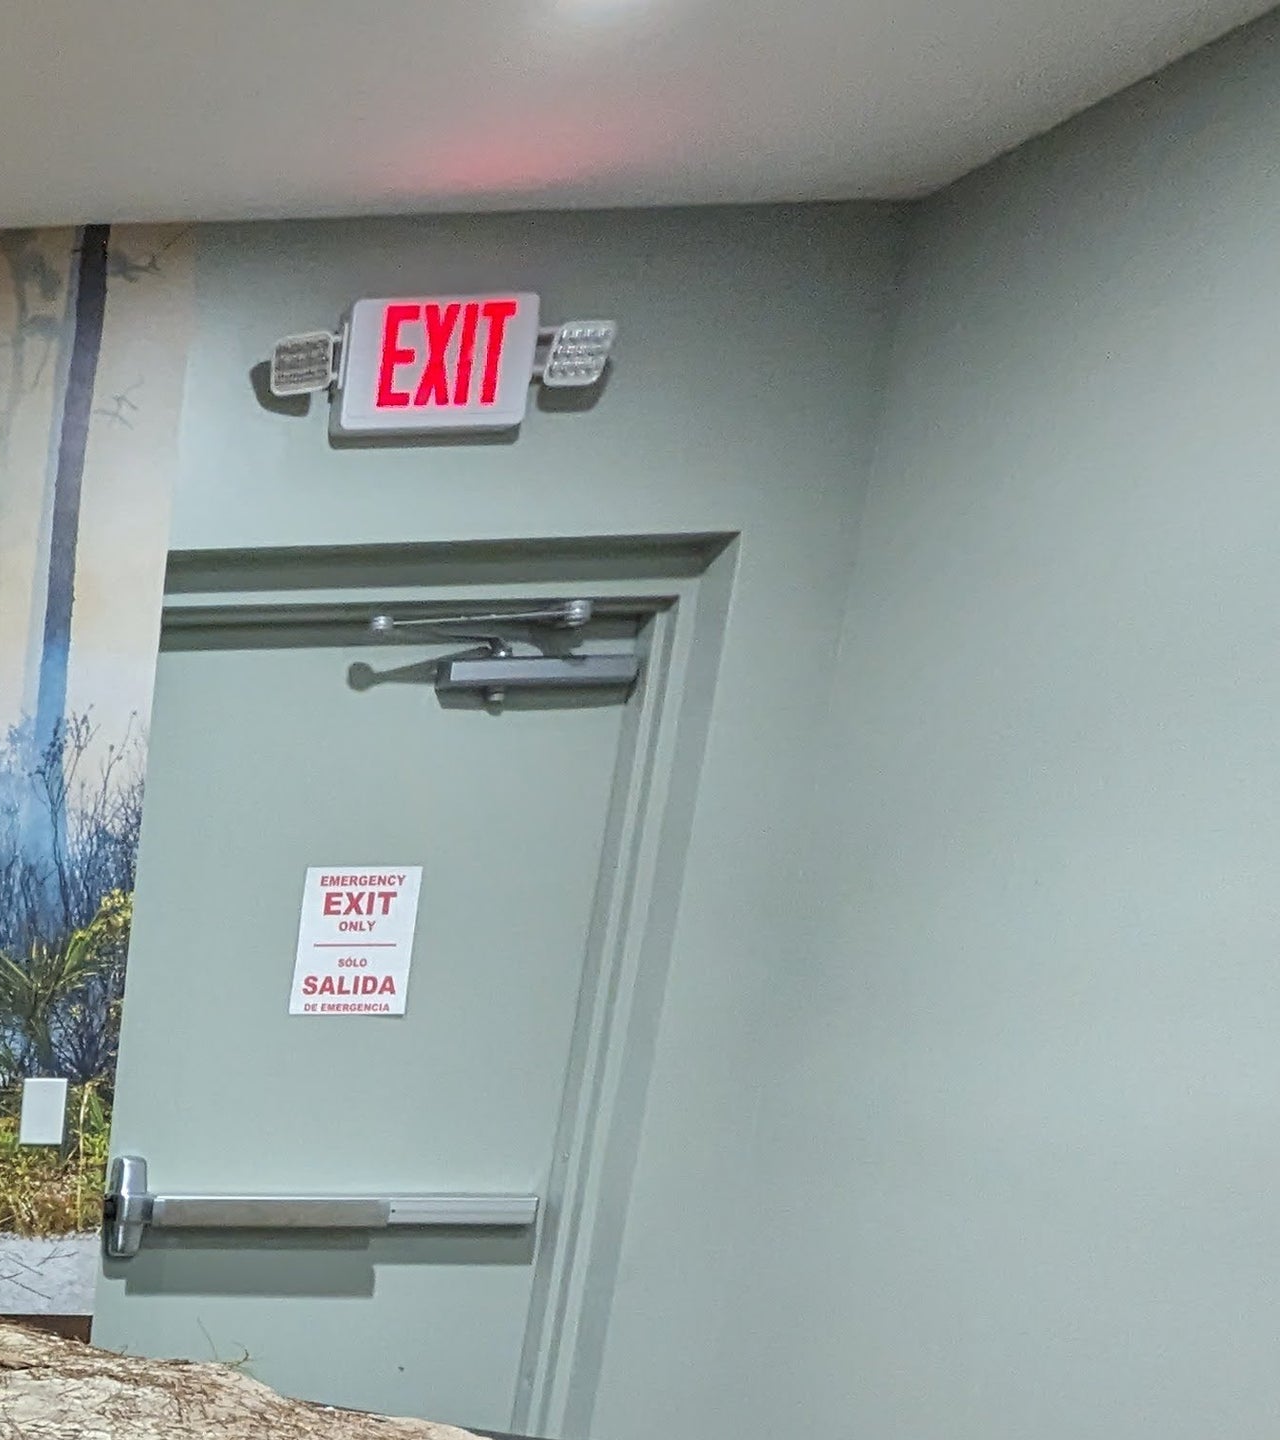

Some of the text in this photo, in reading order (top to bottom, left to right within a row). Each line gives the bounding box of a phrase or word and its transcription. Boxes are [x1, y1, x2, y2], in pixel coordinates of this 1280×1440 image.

[377, 301, 517, 408] EXIT
[321, 875, 406, 886] EMERGENCY
[323, 892, 397, 916] EXIT
[339, 921, 376, 931] ONLY
[338, 957, 367, 967] SÓLO
[303, 976, 396, 995] SALIDA
[321, 1003, 389, 1011] EMERGENCIA
